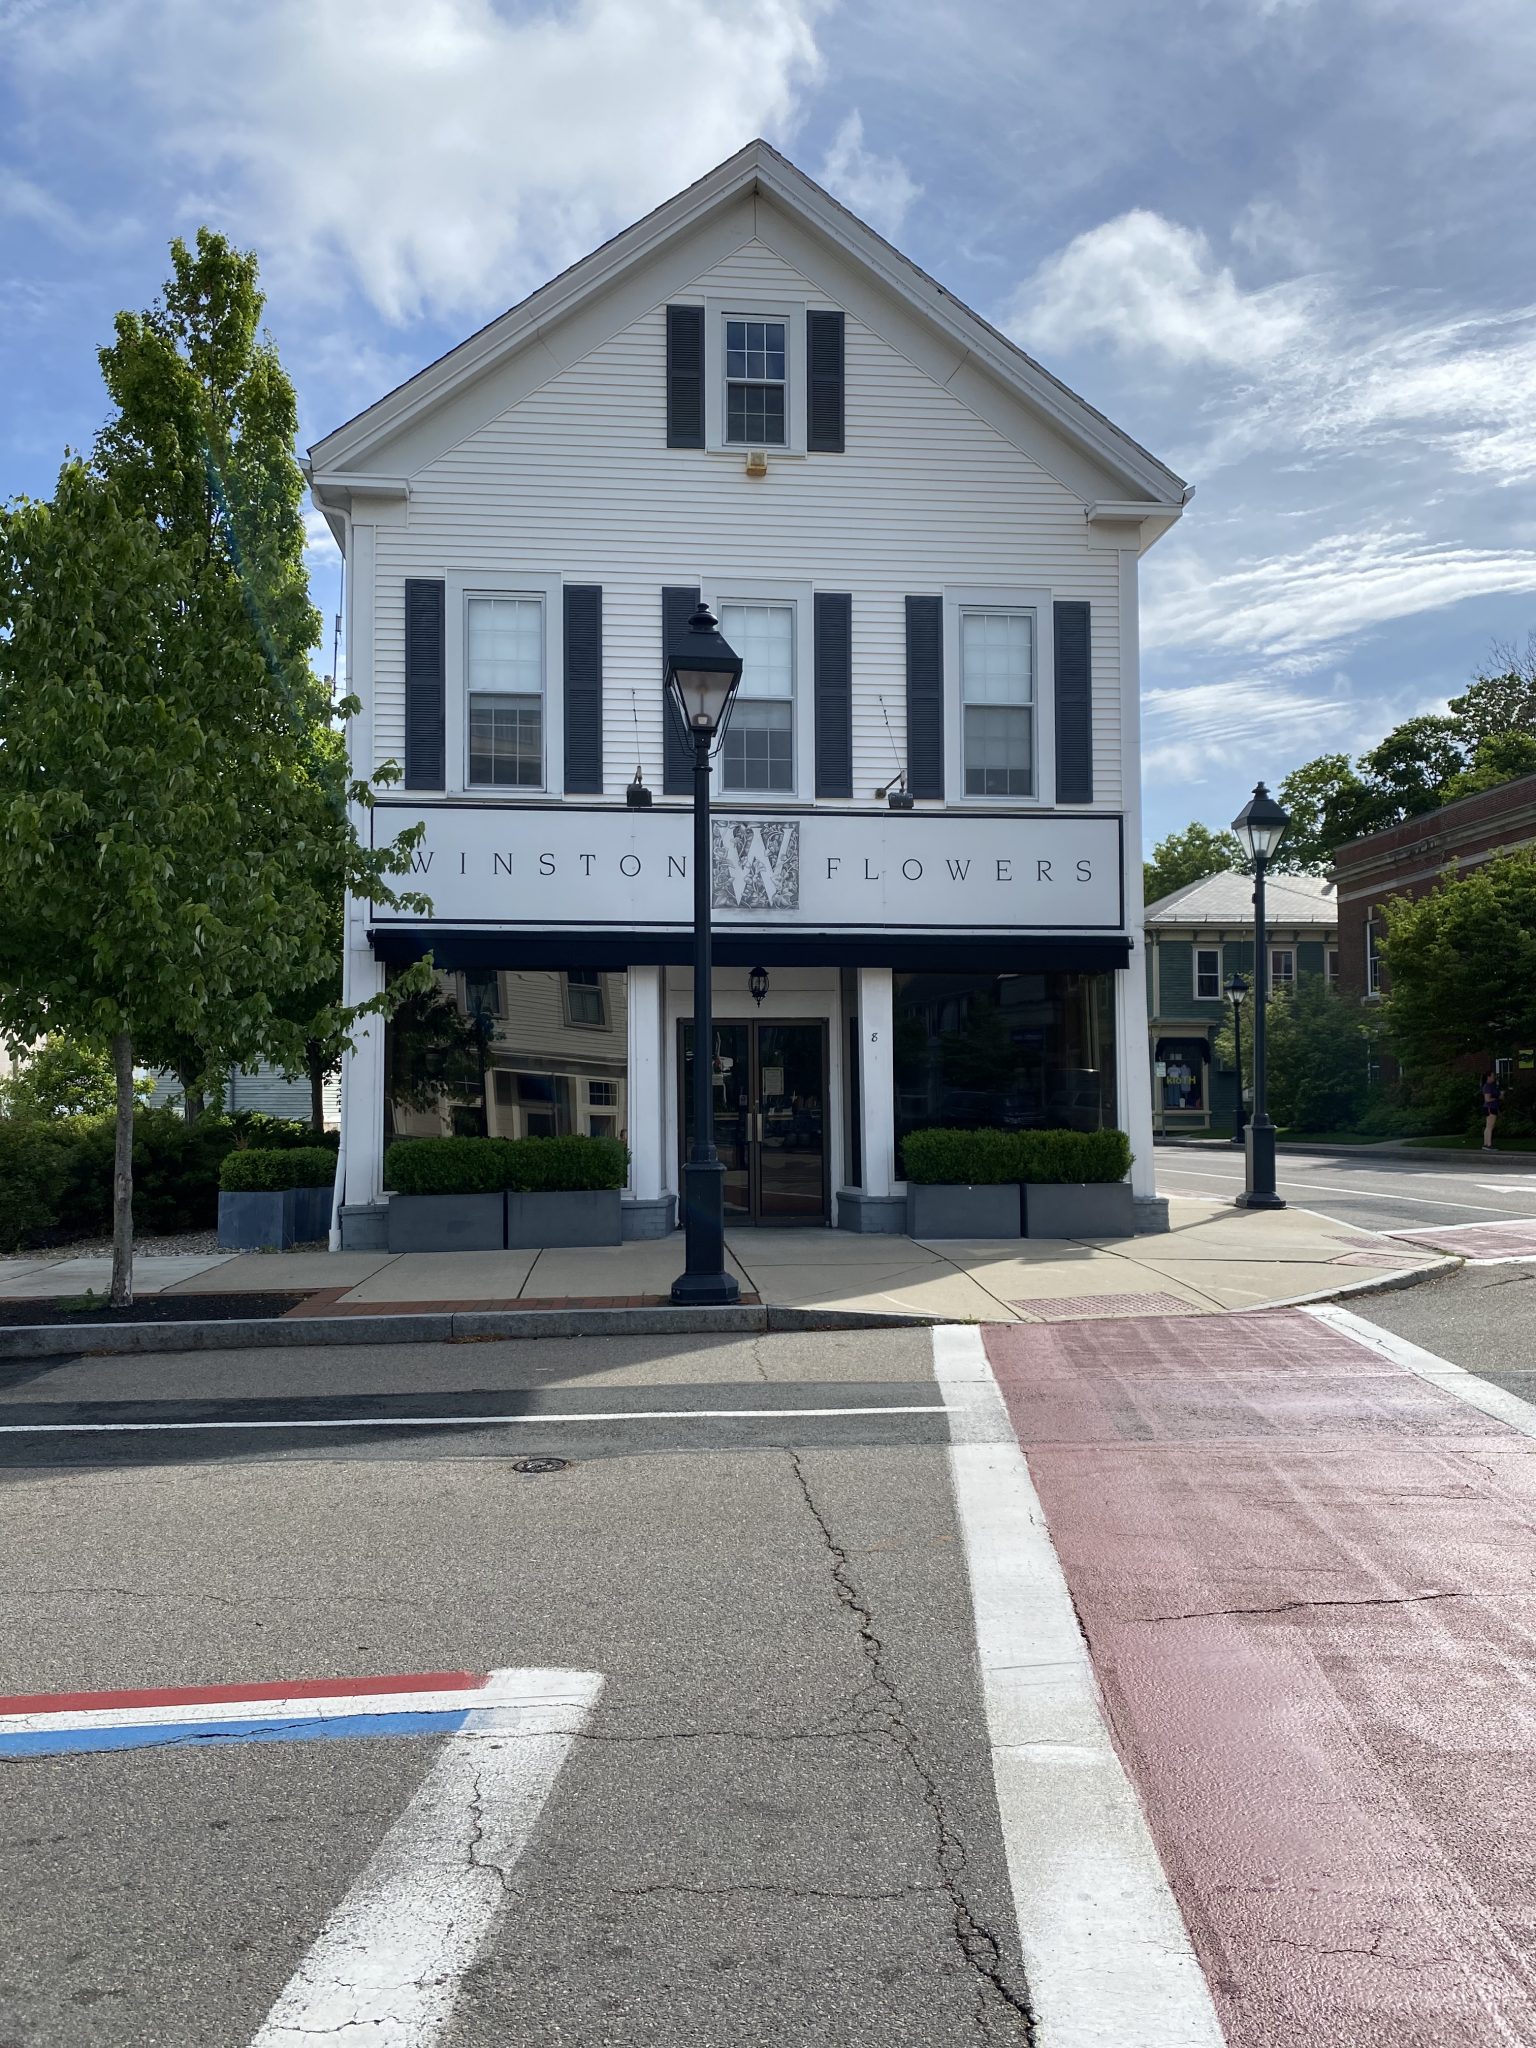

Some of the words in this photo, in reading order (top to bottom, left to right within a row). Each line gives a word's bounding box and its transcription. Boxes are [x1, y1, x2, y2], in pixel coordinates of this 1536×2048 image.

[407, 851, 687, 878] WINSTON
[826, 857, 1093, 882] FLOWERS
[716, 826, 795, 906] W
